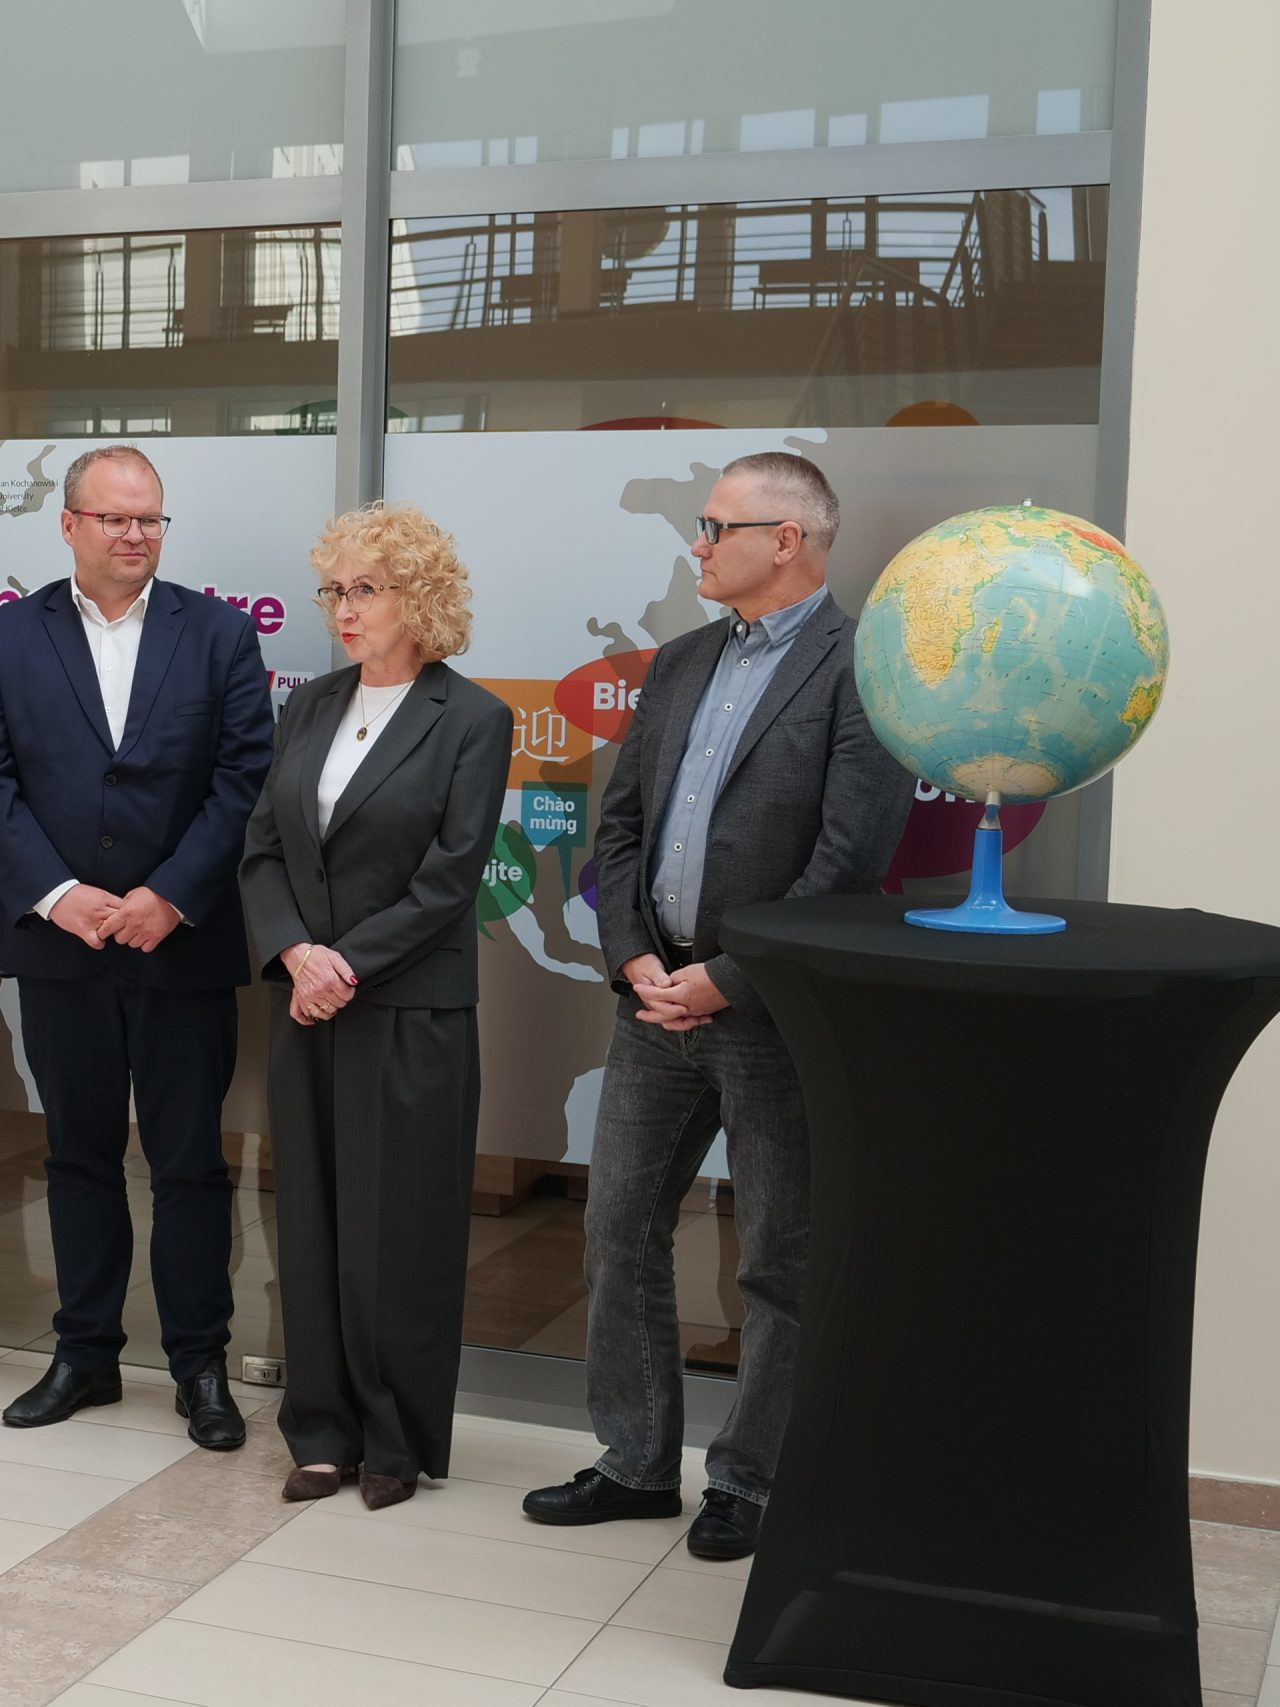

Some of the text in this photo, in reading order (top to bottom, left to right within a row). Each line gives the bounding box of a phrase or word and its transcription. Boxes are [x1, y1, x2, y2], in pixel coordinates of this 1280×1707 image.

[11, 479, 59, 488] Kochanowski
[5, 504, 28, 513] Kielce
[533, 795, 575, 812] Chào
